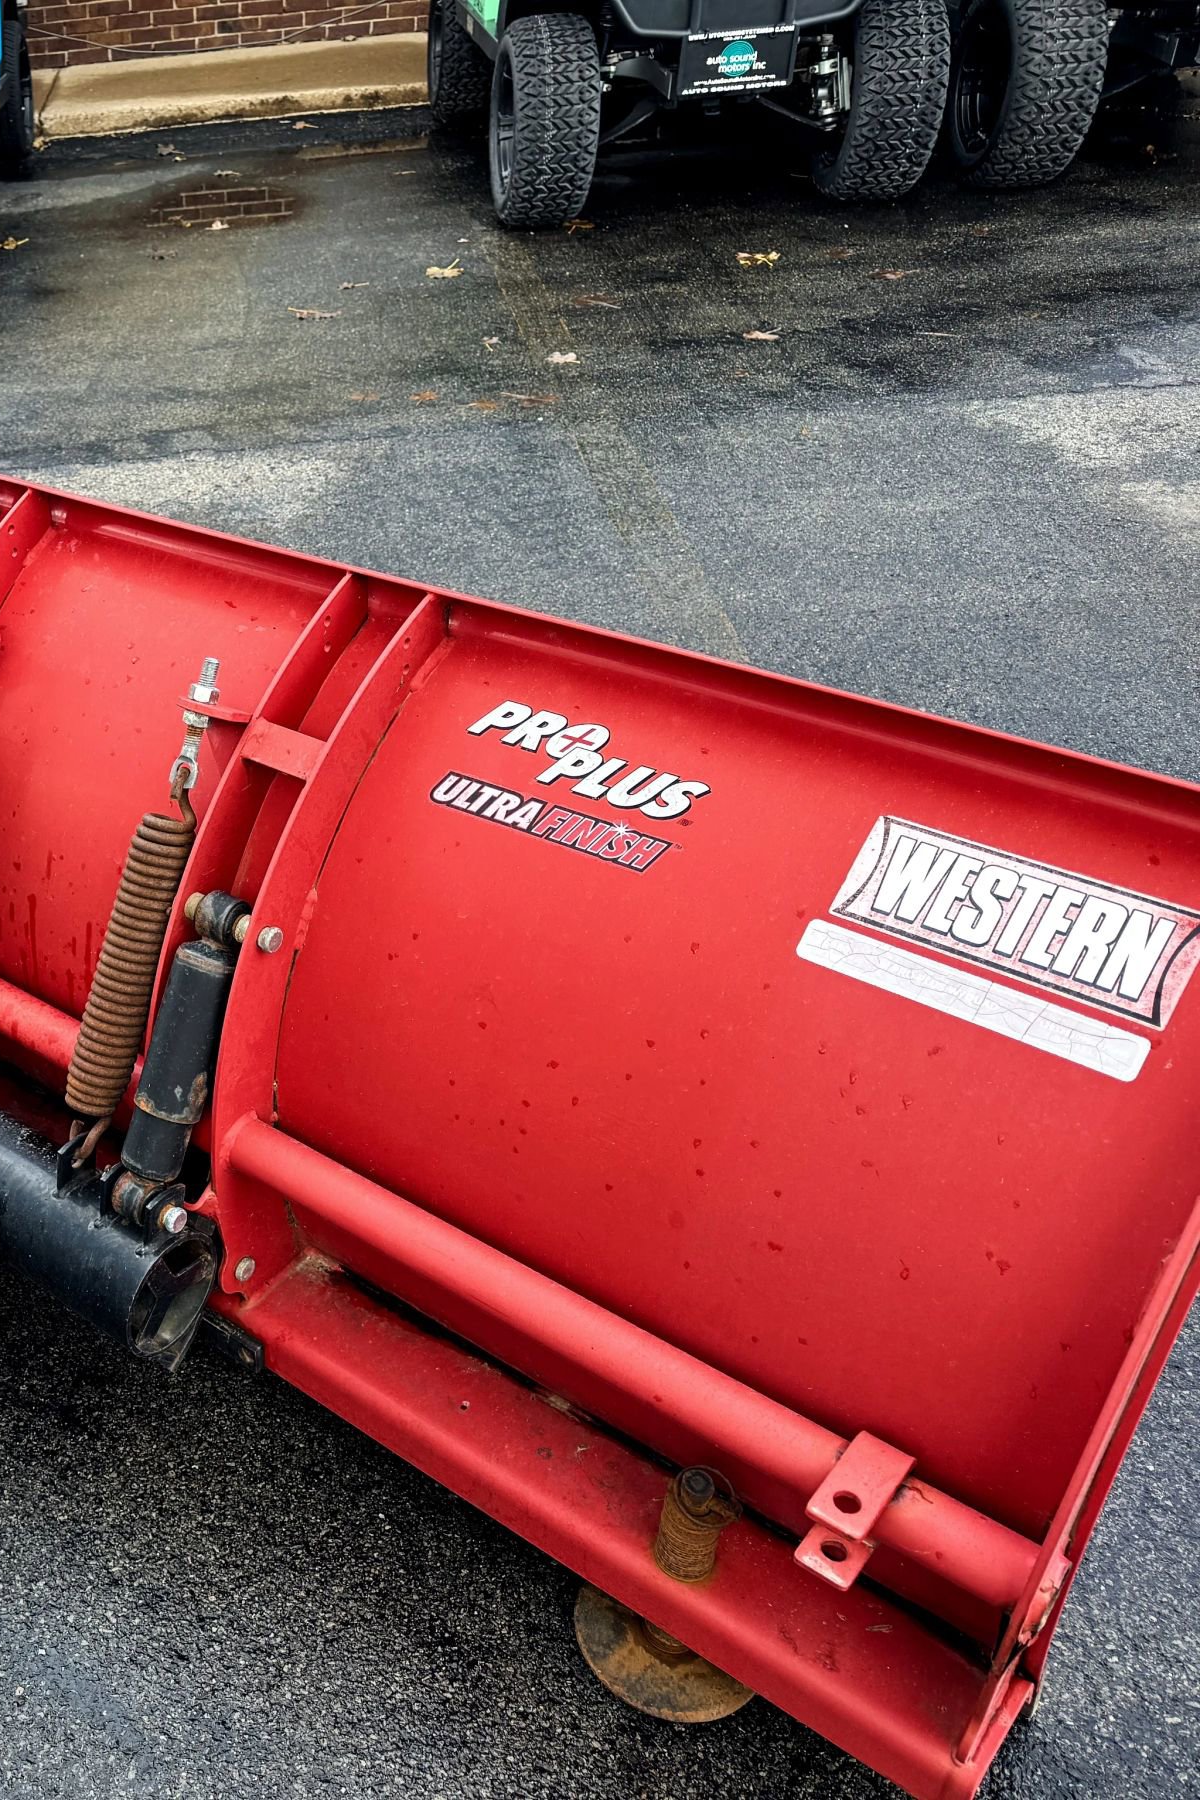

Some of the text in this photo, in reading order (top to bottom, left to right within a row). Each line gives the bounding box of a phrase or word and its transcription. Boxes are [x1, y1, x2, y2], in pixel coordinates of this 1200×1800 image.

[706, 51, 758, 65] auto sound
[718, 60, 767, 73] motors inc
[681, 80, 787, 95] AUTO SOUND MOTORS
[465, 700, 611, 761] PRO
[535, 746, 712, 821] PLUS
[870, 834, 1178, 1003] WESTERN
